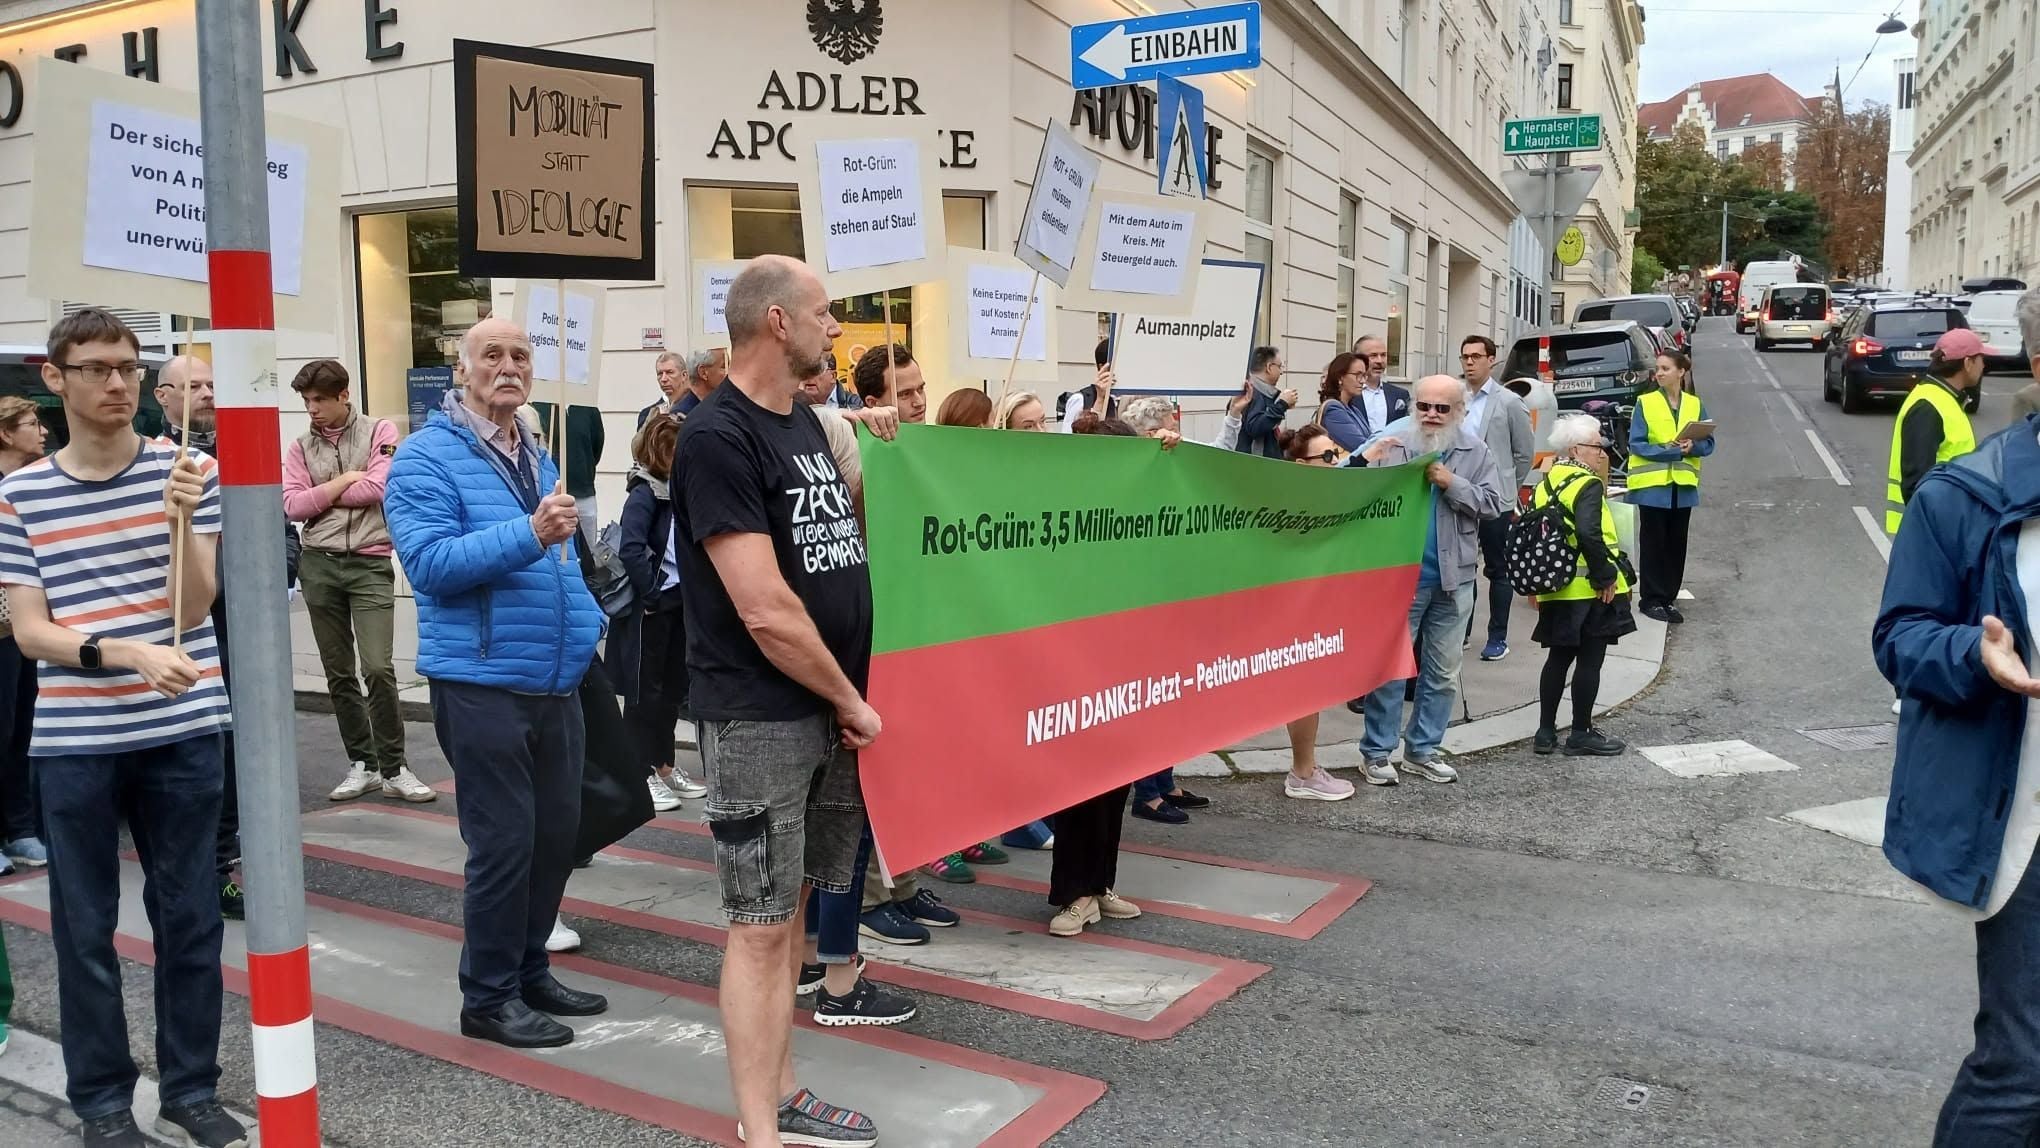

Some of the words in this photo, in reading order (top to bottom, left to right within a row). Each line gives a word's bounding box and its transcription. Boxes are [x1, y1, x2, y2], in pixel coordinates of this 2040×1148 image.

[1130, 24, 1237, 64] EINBAHN
[757, 69, 927, 116] ADLER
[1523, 119, 1575, 134] Hernalser
[110, 122, 148, 146] Der
[152, 134, 204, 158] siche
[266, 156, 289, 180] eg
[1524, 133, 1573, 149] Hauptstr.
[541, 151, 590, 171] STATT
[843, 155, 897, 173] Rot-Grün:
[1052, 155, 1066, 174] ROT
[1068, 167, 1084, 190] GRÜN
[131, 164, 168, 184] von
[172, 169, 187, 187] A
[841, 187, 860, 204] die
[861, 185, 903, 206] Ampeln
[1051, 187, 1072, 210] müssen
[156, 198, 206, 223] Politi
[492, 189, 632, 242] IDEOLOGIE
[1041, 208, 1069, 235] einlenken!
[1108, 213, 1125, 225] Mit
[1126, 215, 1147, 227] dem
[1148, 218, 1170, 230] Auto
[1171, 220, 1183, 231] im
[830, 218, 869, 236] stehen
[871, 214, 890, 231] auf
[891, 211, 917, 230] Stau!
[127, 228, 207, 254] unerwü
[1122, 234, 1149, 247] Kreis.
[1150, 237, 1166, 248] Mit
[1101, 251, 1153, 267] Steuergeld
[1153, 257, 1178, 268] auch.
[972, 287, 994, 299] Keine
[994, 289, 1039, 303] Experimete
[541, 312, 566, 326] Polit
[566, 316, 578, 329] der
[980, 308, 993, 317] auf
[994, 308, 1019, 320] Kosten
[1020, 310, 1032, 320] dr
[990, 326, 1019, 338] Anraine
[1135, 316, 1237, 341] Aumannplatz
[529, 331, 560, 348] logische
[566, 338, 586, 352] Mitte!
[921, 511, 1035, 556] Rot-Grün:
[1040, 510, 1071, 553] 3,5
[1074, 507, 1154, 543] Millionen
[1157, 505, 1184, 537] für
[1185, 504, 1210, 535] 100
[1211, 503, 1253, 533] Meter
[1369, 495, 1403, 519] Stau?
[1025, 698, 1077, 746] NEIN
[1080, 679, 1142, 731] DANKE!
[1144, 671, 1181, 709] Jetzt
[1196, 653, 1249, 692] Petition
[1250, 628, 1345, 677] unterschreiben!
